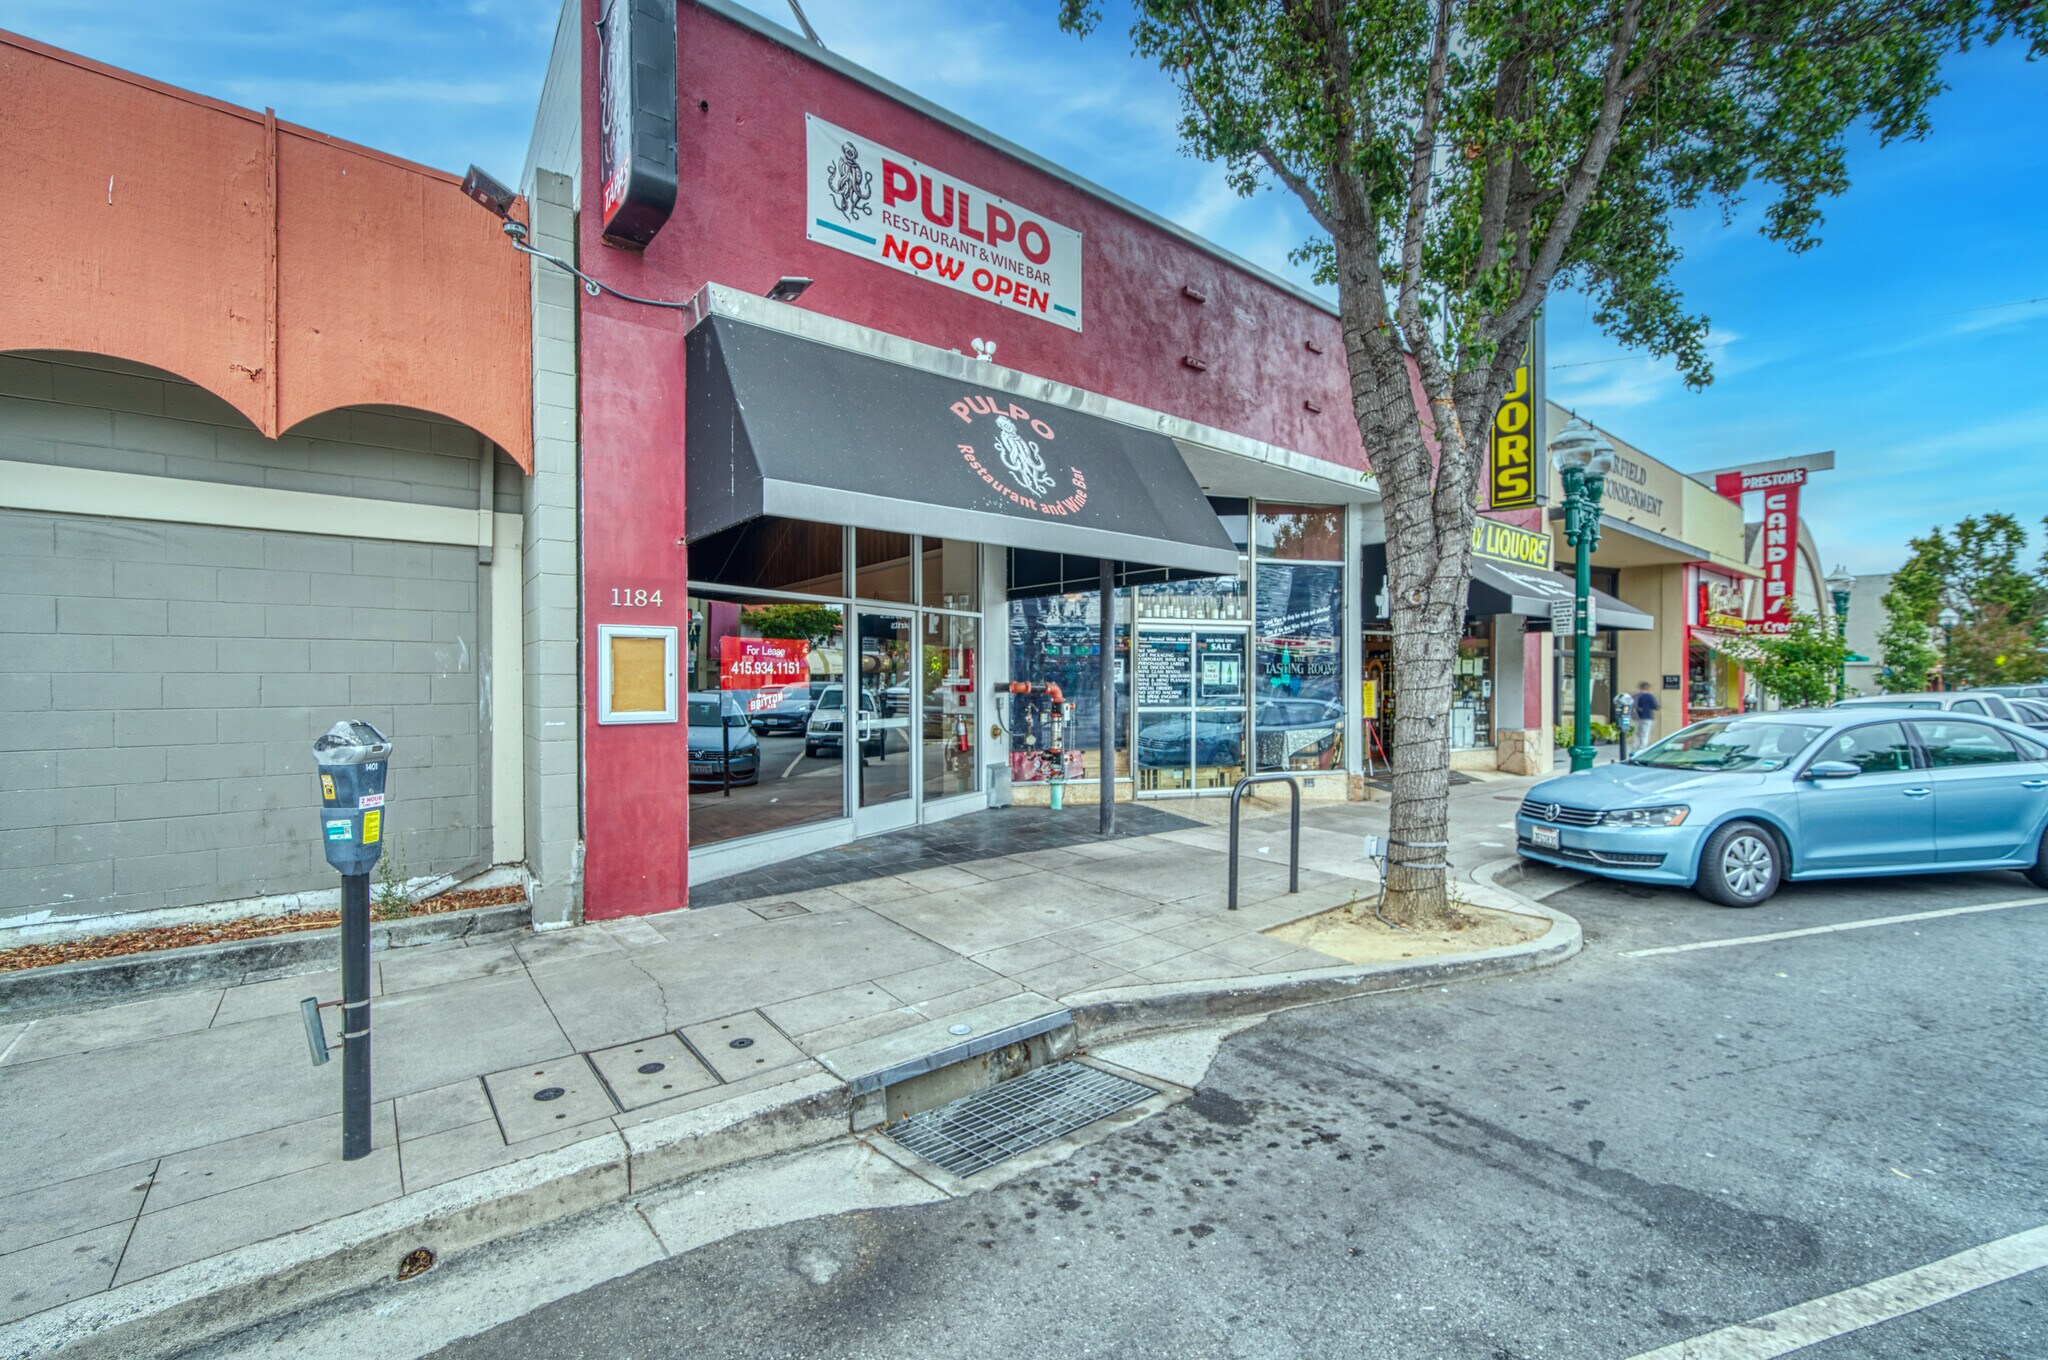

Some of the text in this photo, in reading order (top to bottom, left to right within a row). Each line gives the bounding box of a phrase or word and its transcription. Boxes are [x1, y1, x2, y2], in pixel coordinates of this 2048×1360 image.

[604, 156, 630, 212] TAPAS
[882, 157, 1051, 265] PULPO
[882, 209, 1051, 286] RESTAURANT & WINE BAR
[882, 234, 1050, 313] NOW OPEN
[950, 395, 1055, 440] PULPO
[957, 444, 1088, 516] Restaurant and Wine Bar
[1612, 454, 1647, 486] RFIELD
[1742, 469, 1804, 489] PRESTON'S
[1486, 525, 1547, 565] LIQUORS
[1766, 494, 1788, 614] CANDIES
[611, 588, 663, 607] 1184
[747, 645, 785, 657] For Lease
[731, 661, 800, 675] 415.934.1151
[1265, 662, 1337, 675] TASTING ROOM
[750, 692, 783, 710] BRITTON
[366, 763, 378, 771] 1401
[366, 795, 382, 803] HOUR
